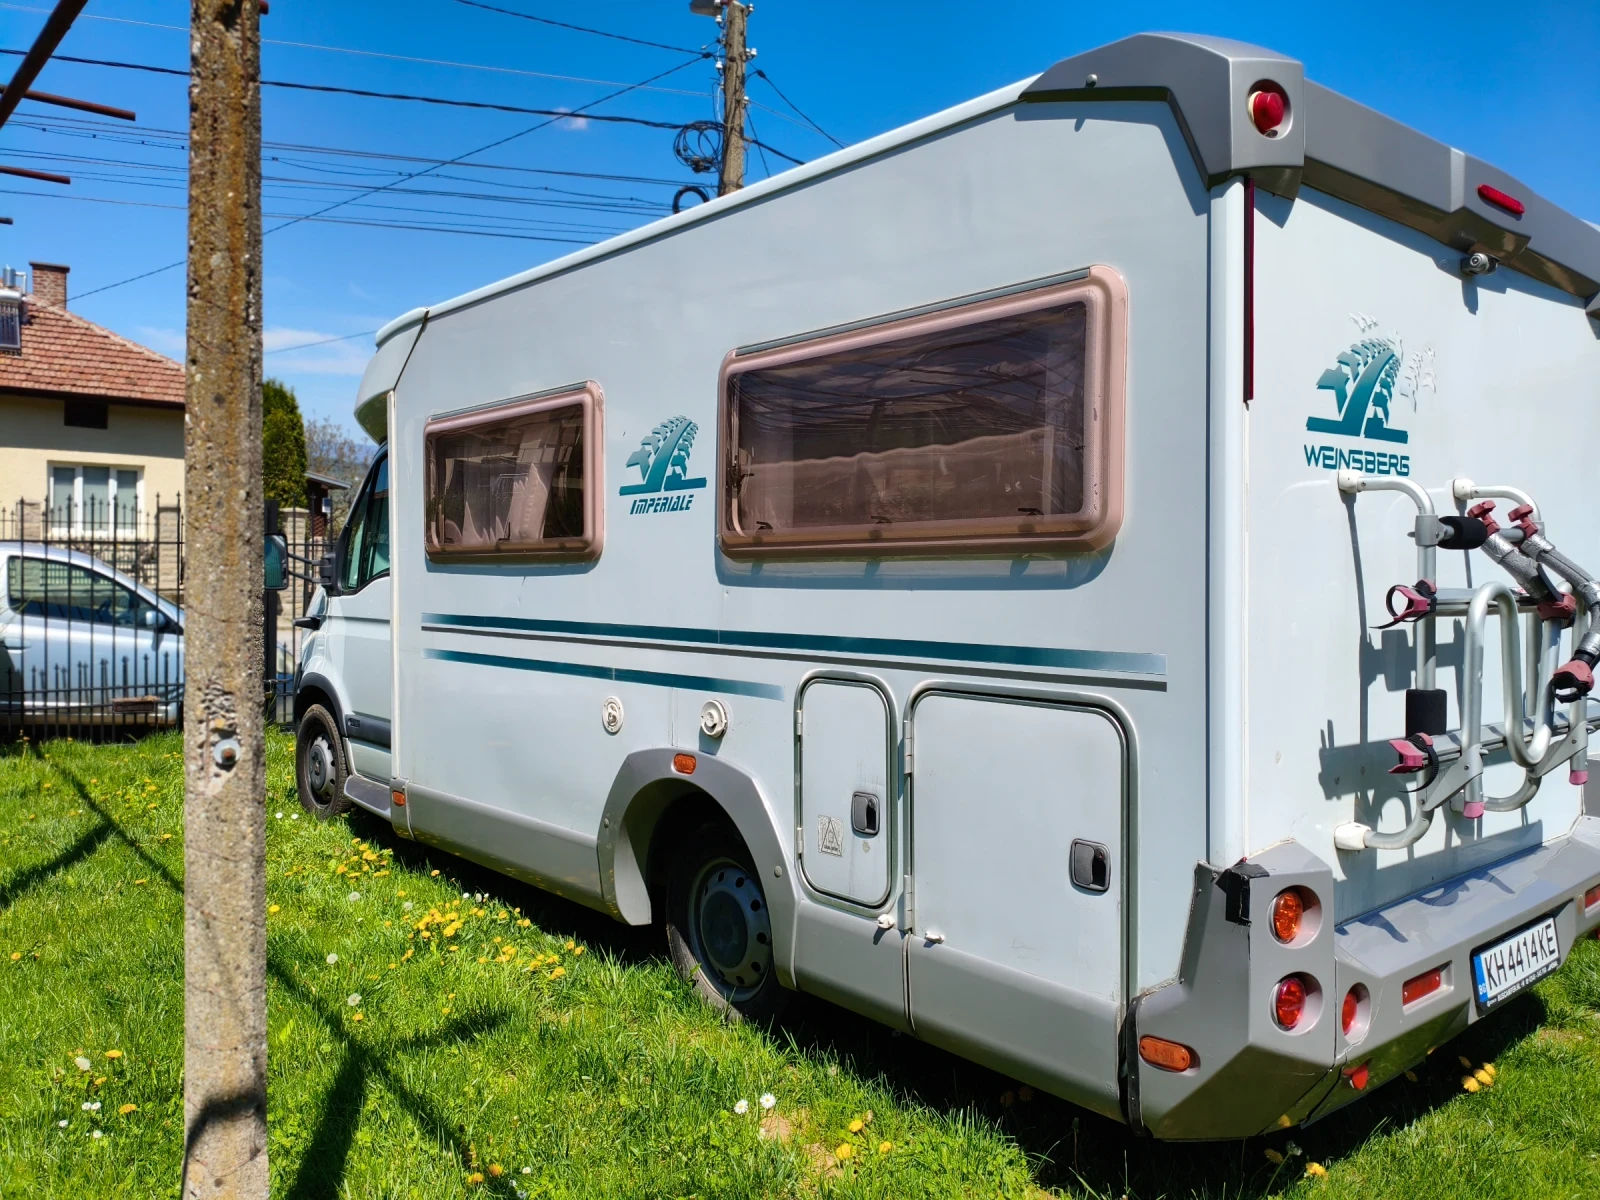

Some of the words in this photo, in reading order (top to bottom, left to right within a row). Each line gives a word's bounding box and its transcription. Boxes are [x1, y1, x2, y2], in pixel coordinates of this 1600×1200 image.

[1303, 444, 1410, 477] WEINSBERG
[629, 494, 695, 515] IMPERIALE
[1478, 982, 1487, 996] BG
